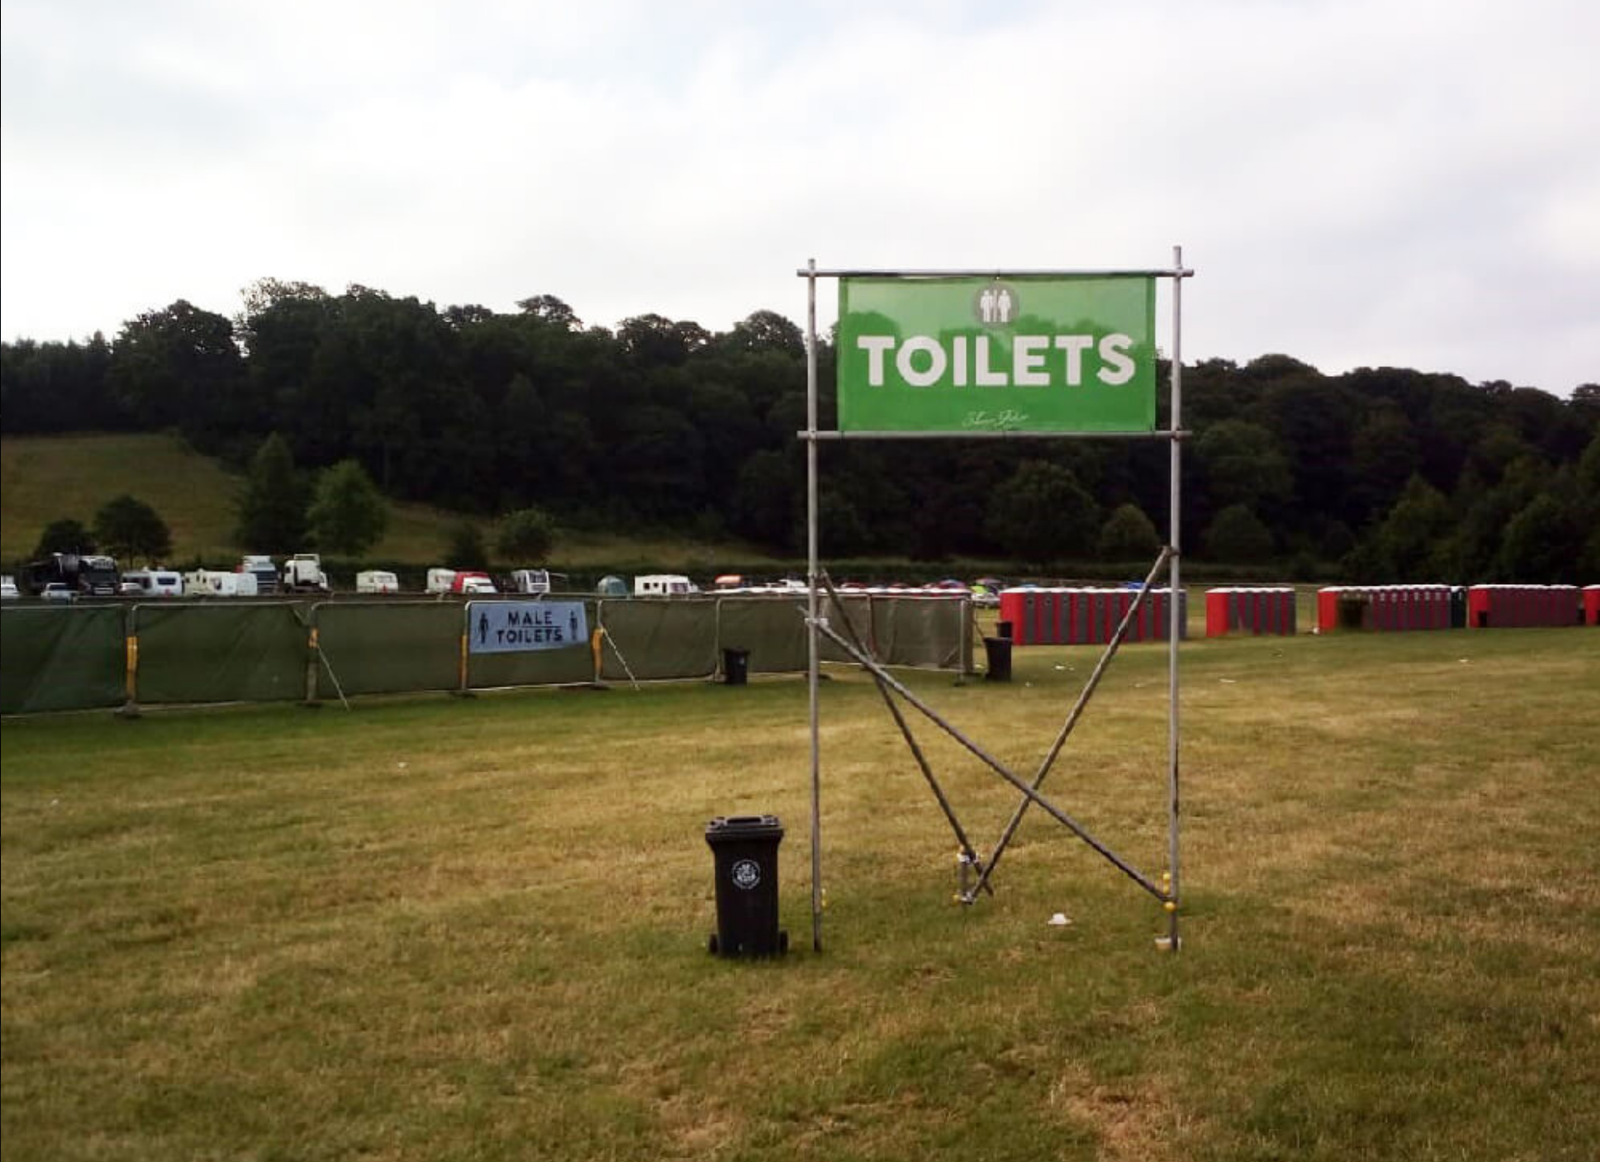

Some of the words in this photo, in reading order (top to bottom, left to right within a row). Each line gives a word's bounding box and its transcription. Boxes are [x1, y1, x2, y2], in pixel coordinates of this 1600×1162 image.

[857, 334, 1136, 387] TOILETS
[508, 611, 553, 626] MALE
[497, 629, 563, 644] TOILETS
